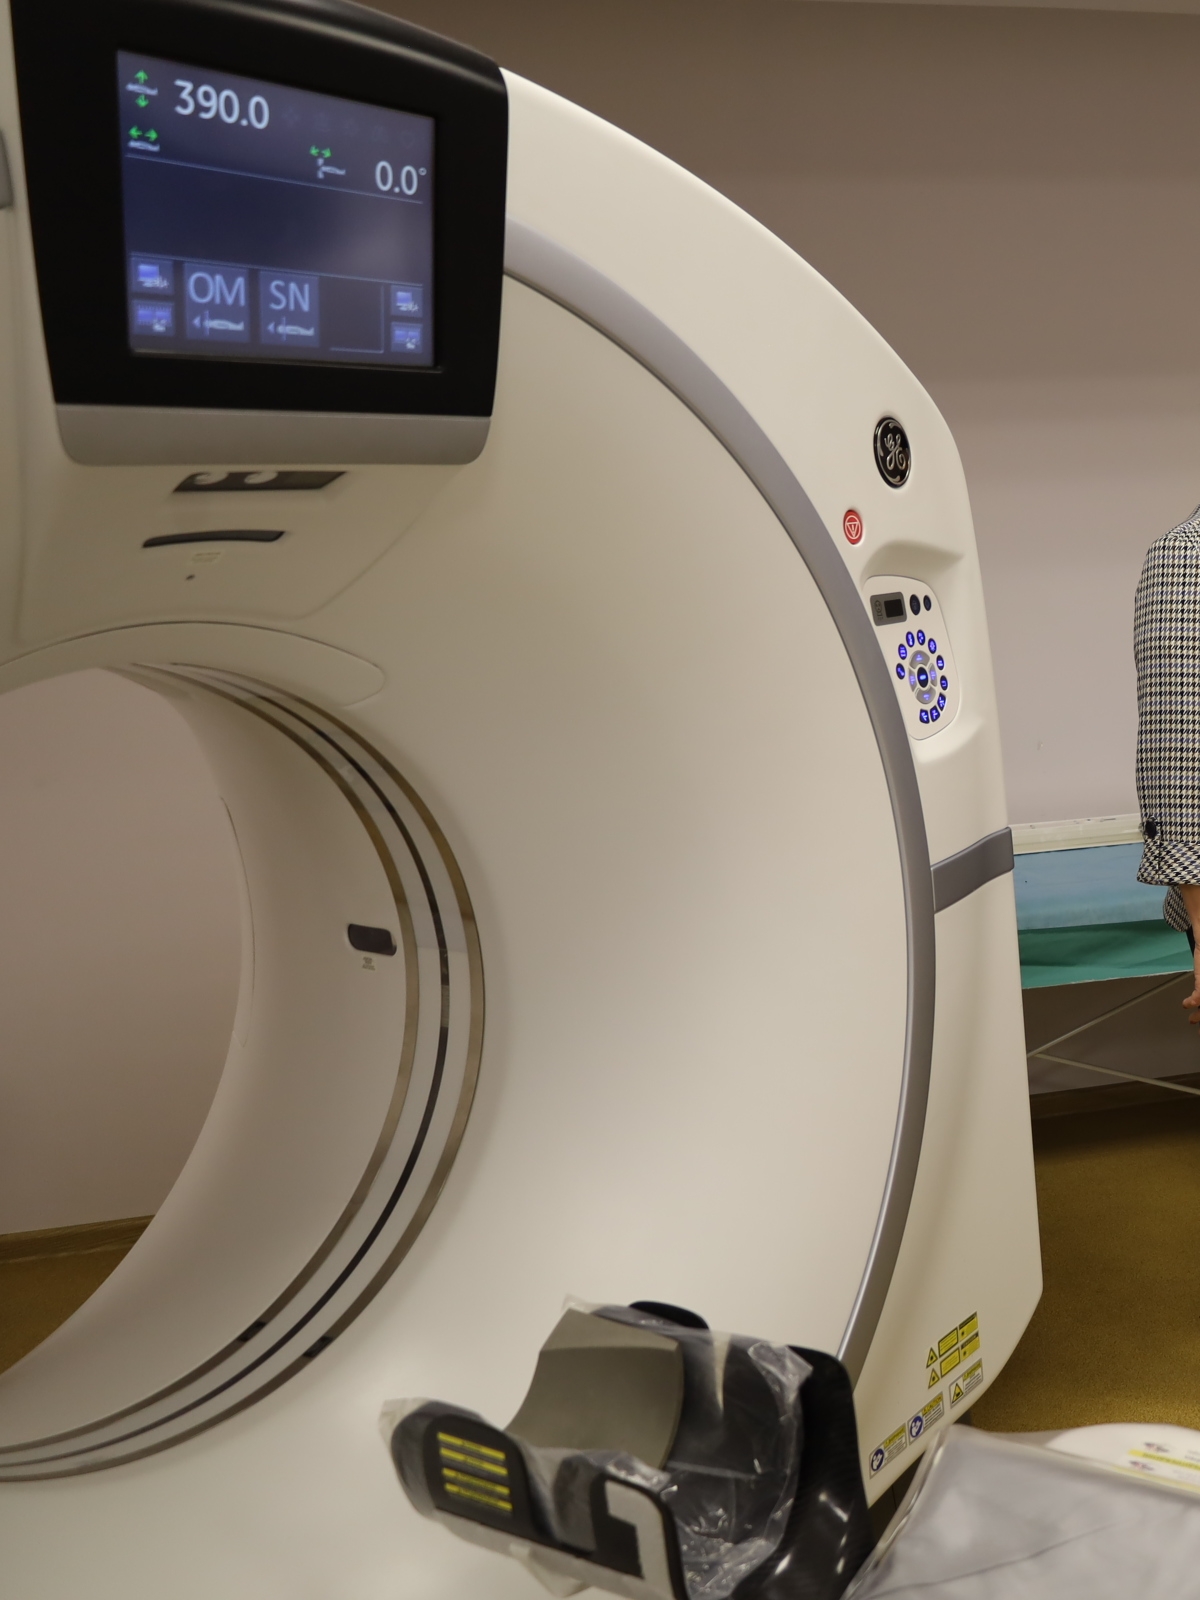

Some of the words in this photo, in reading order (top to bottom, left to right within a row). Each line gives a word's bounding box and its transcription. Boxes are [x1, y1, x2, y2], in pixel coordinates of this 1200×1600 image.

[173, 79, 270, 130] 390.0
[187, 271, 247, 307] OM
[268, 280, 311, 313] SN
